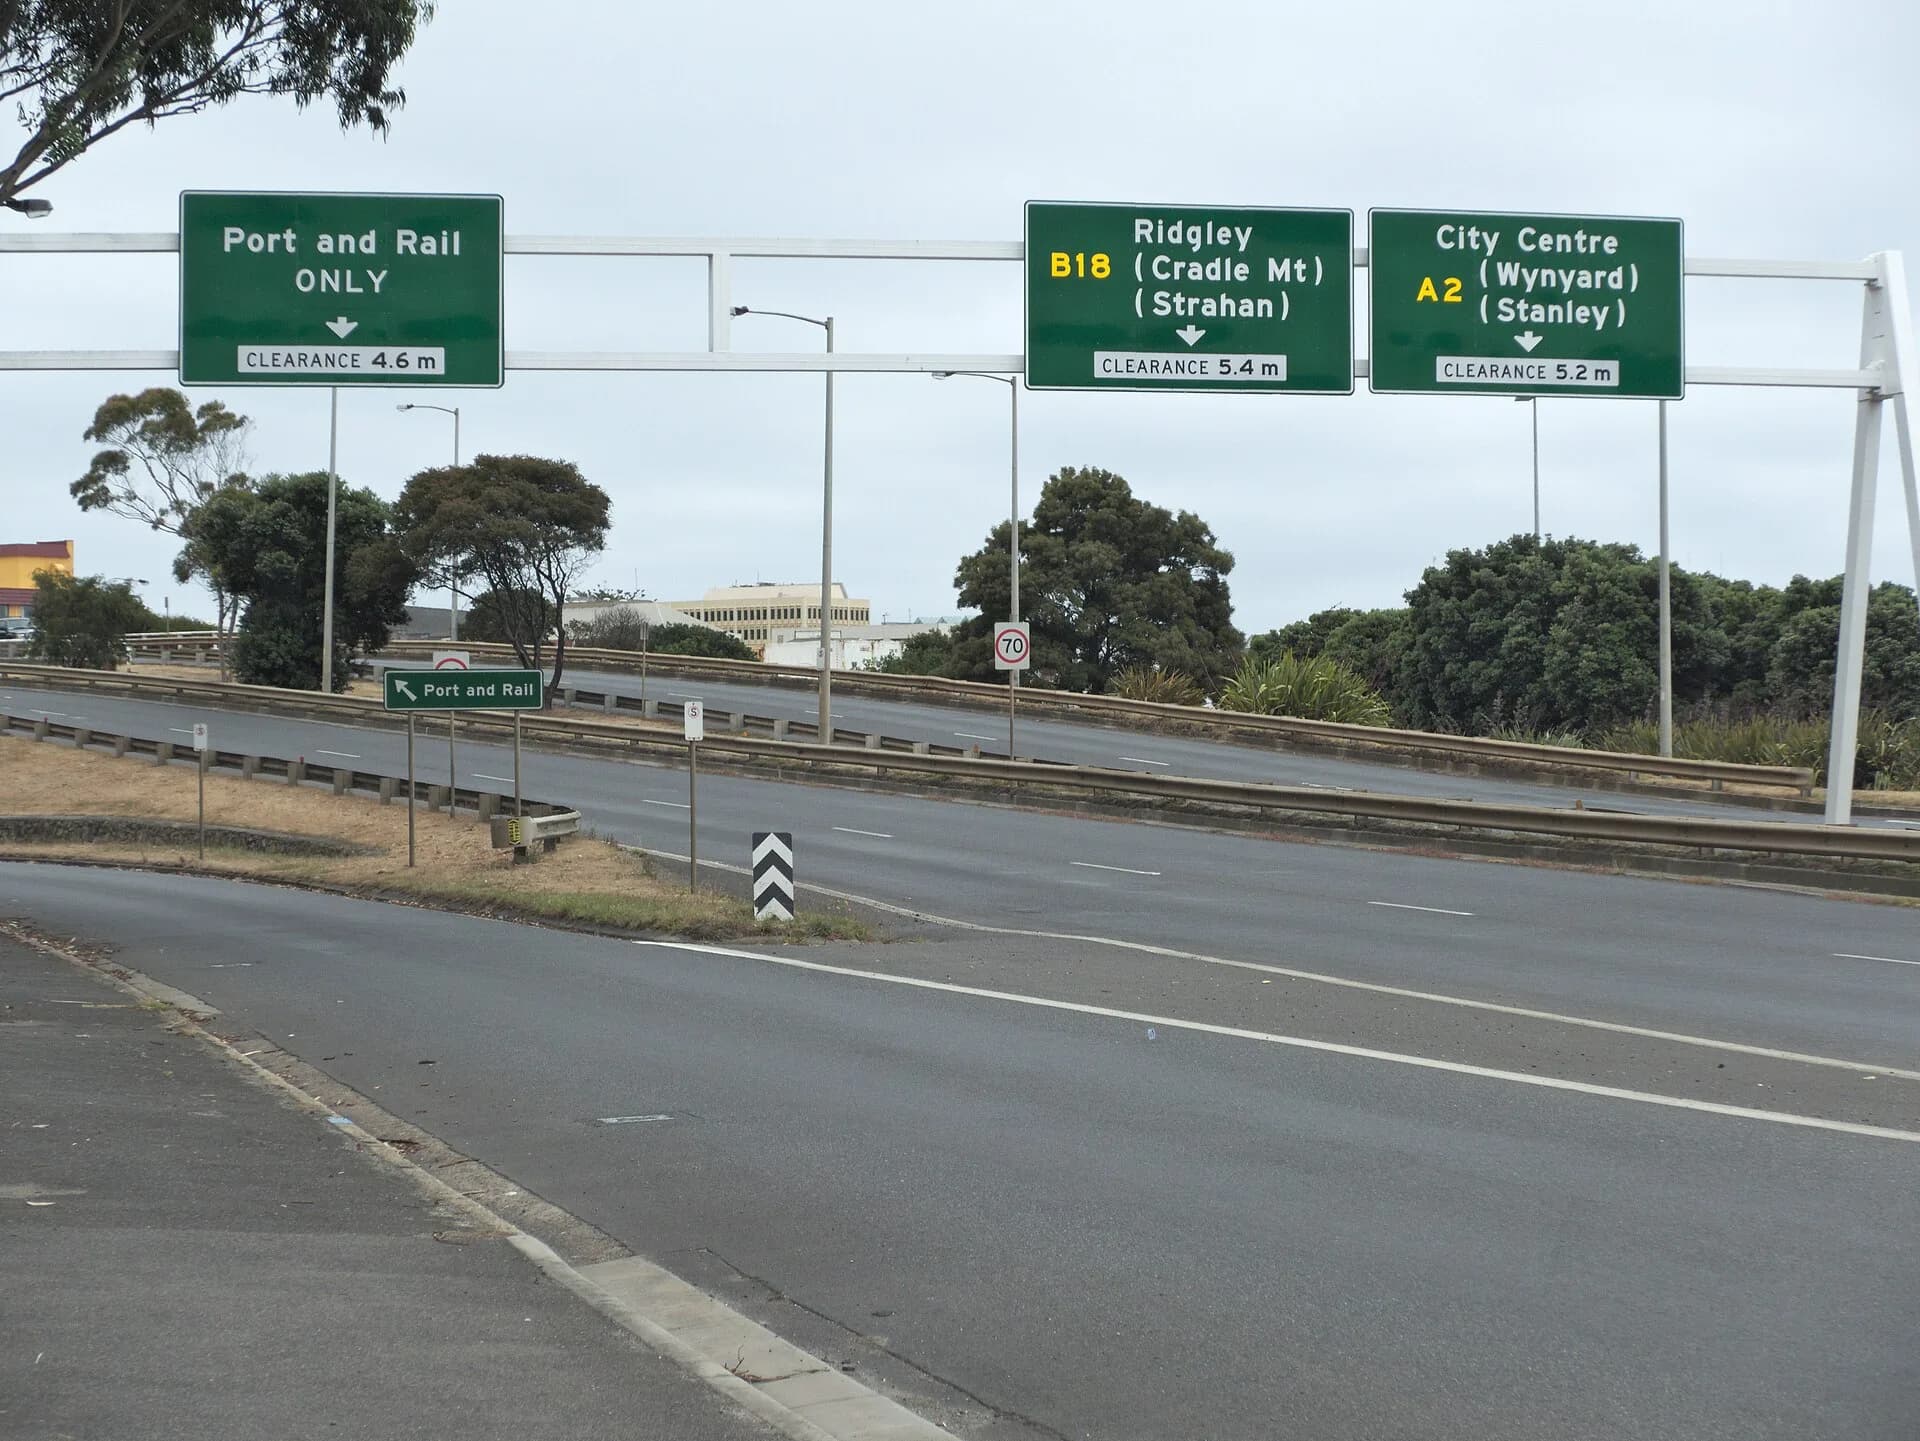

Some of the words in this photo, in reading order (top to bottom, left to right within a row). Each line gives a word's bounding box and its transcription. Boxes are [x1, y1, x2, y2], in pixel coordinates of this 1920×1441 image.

[224, 227, 296, 253] Port
[317, 229, 376, 254] and
[396, 229, 460, 256] Rail
[1135, 219, 1252, 252] Ridgley
[1436, 225, 1500, 256] City
[1518, 227, 1619, 255] Centre
[1051, 252, 1111, 279] B18
[295, 269, 388, 293] ONLY
[1416, 277, 1463, 302] A2
[247, 352, 361, 368] CLEARANCE
[371, 353, 410, 369] 4.6
[418, 356, 436, 369] m
[1102, 359, 1209, 374] CLEARANCE
[1219, 360, 1254, 375] 5.4
[1262, 363, 1279, 376] m
[1444, 363, 1546, 379] CLEARANCE
[1556, 365, 1587, 380] 5.2
[1594, 368, 1611, 381] m
[1002, 638, 1024, 653] 70
[424, 684, 459, 696] Port
[466, 684, 495, 696] and
[503, 683, 533, 696] Rail
[690, 707, 697, 717] S
